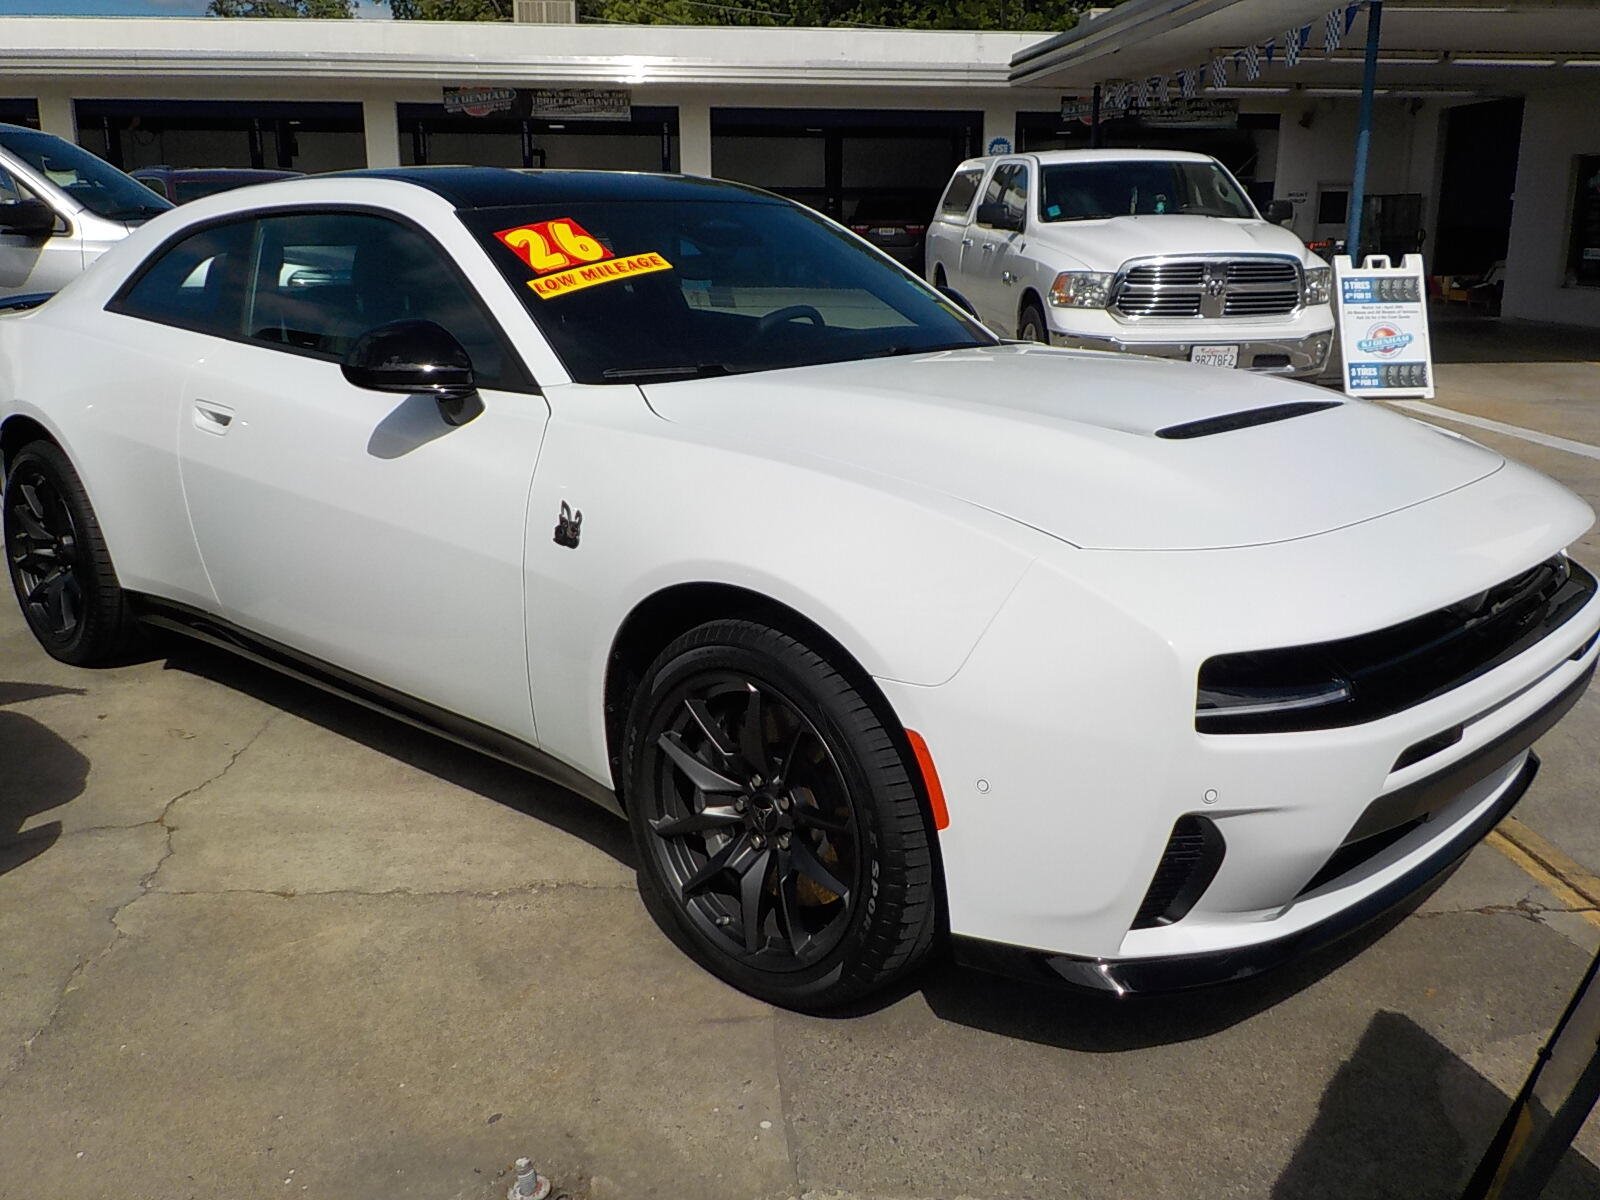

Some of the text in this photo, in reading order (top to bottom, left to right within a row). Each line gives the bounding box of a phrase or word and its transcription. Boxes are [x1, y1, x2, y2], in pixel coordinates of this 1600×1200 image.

[991, 143, 1009, 153] ASE
[504, 221, 604, 272] 26
[533, 255, 664, 294] LOW MILEAGE
